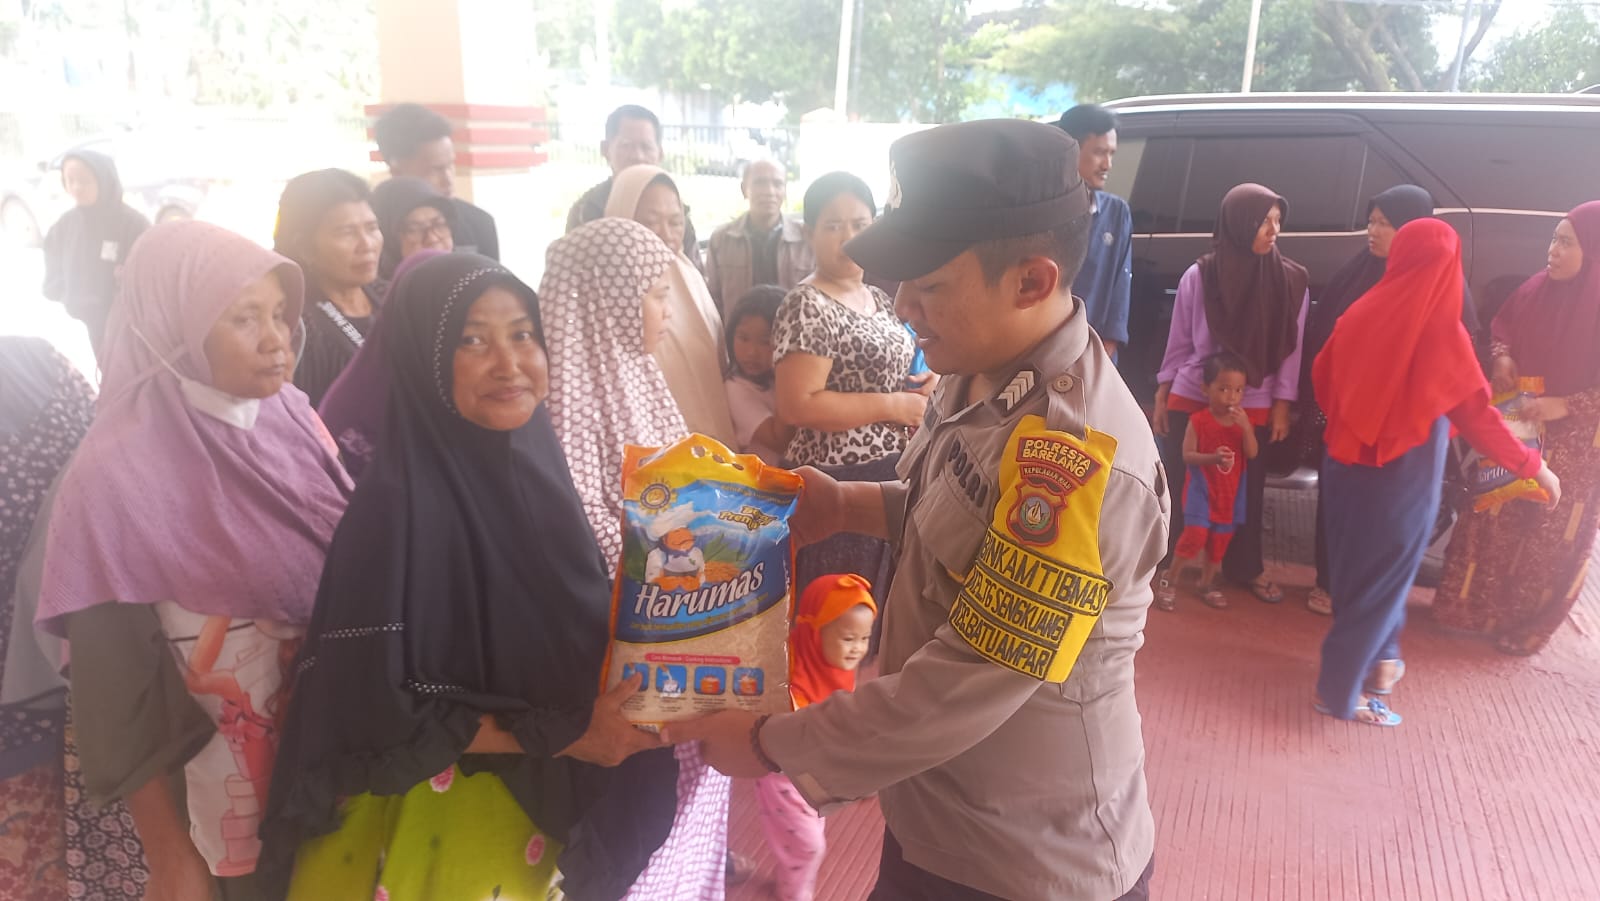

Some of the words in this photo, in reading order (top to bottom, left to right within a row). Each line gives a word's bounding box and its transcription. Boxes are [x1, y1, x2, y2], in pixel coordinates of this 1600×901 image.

[947, 439, 989, 509] POLRI
[1022, 448, 1086, 478] BARELANG
[1024, 439, 1091, 471] POLRESTA
[633, 561, 765, 621] Harumas
[991, 587, 1067, 641] SENGKUANG
[995, 633, 1052, 676] AMPAR
